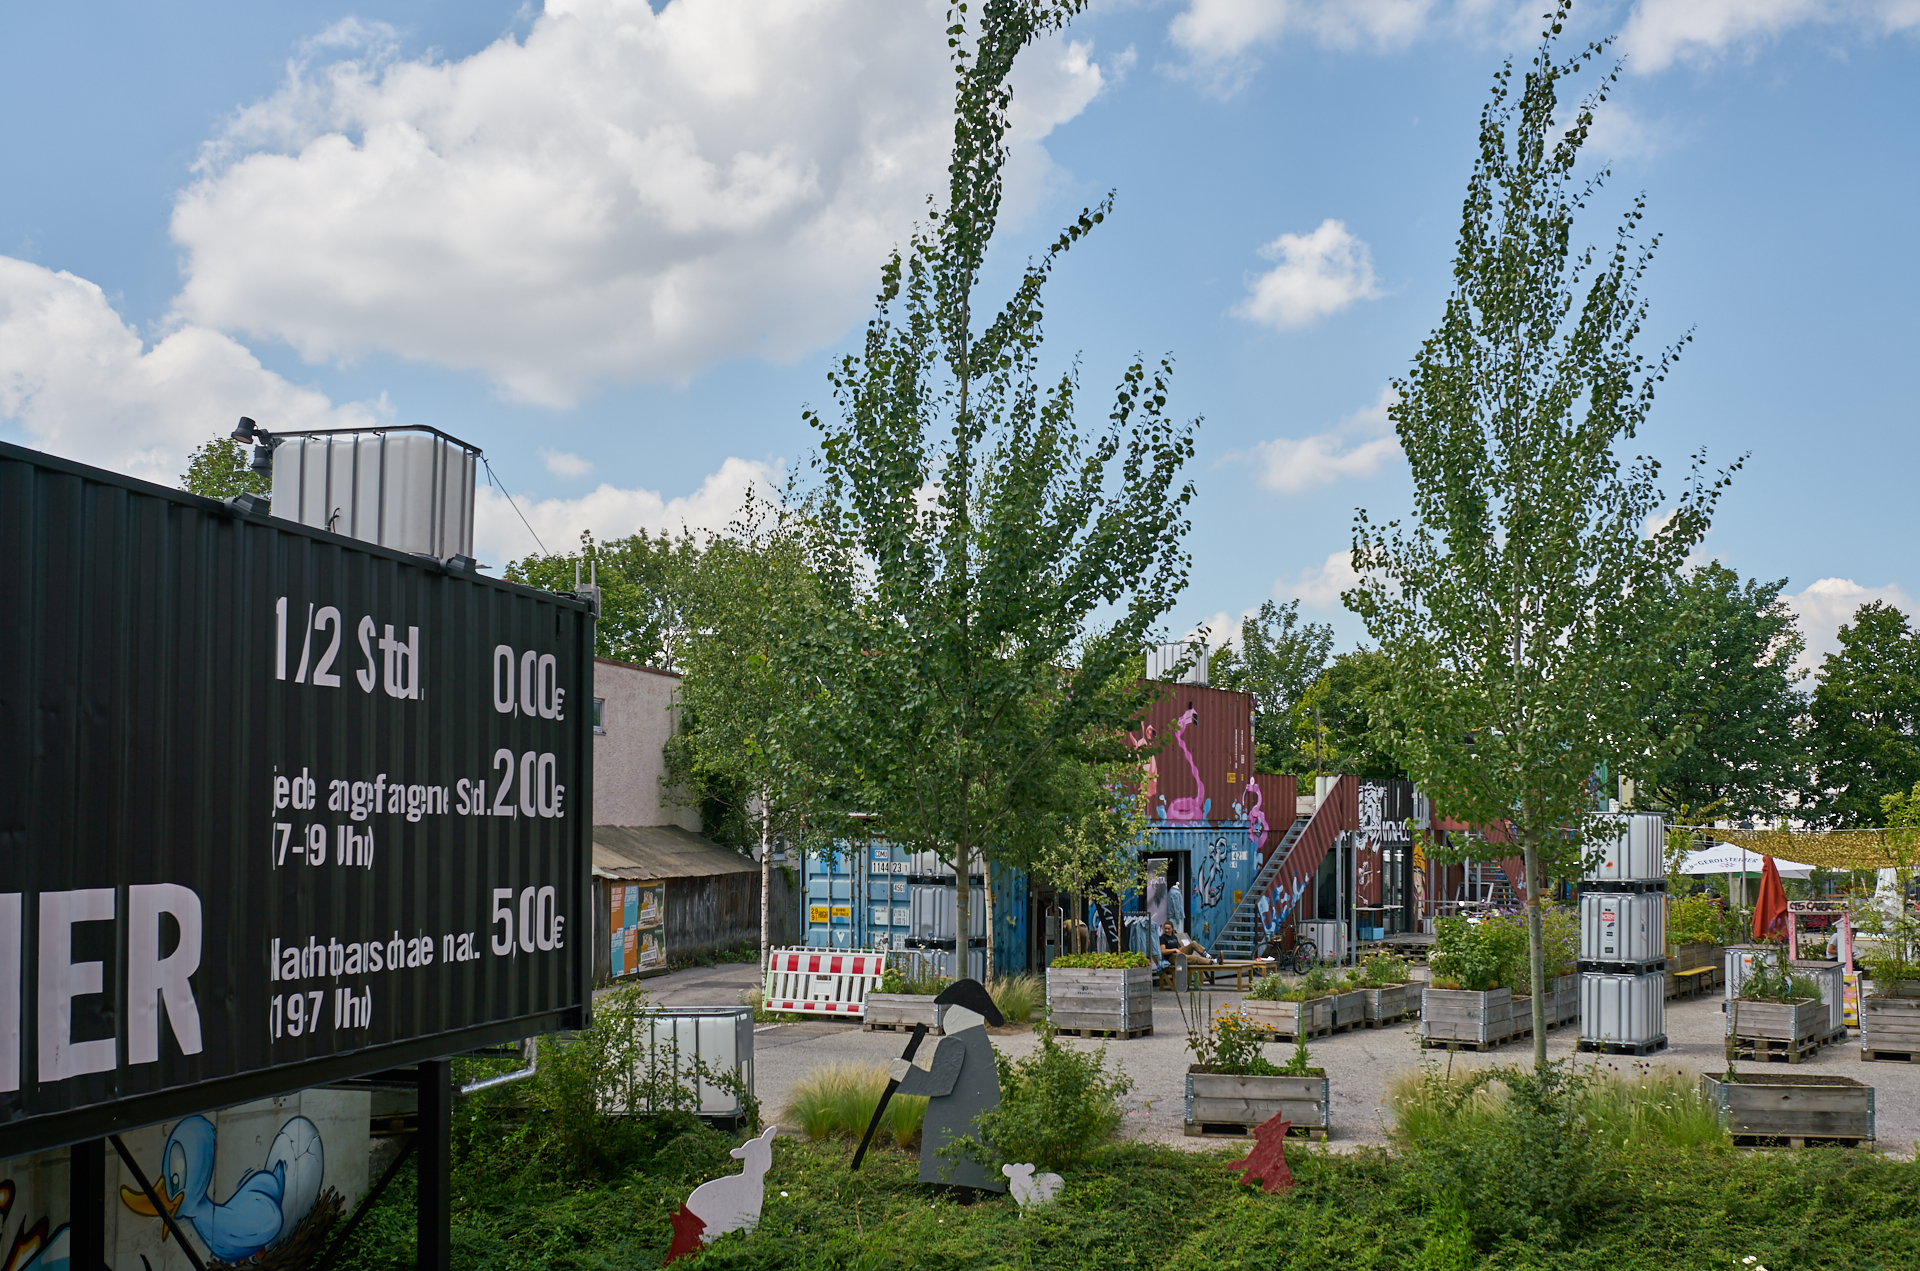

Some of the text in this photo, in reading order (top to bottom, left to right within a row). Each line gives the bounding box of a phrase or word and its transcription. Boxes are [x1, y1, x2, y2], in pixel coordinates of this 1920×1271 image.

[276, 596, 565, 721] 1/2 Std. 0,00€
[272, 765, 316, 817] jede
[493, 748, 565, 821] 2,00€
[272, 822, 327, 870] (7-19
[491, 885, 565, 964] 5,00€
